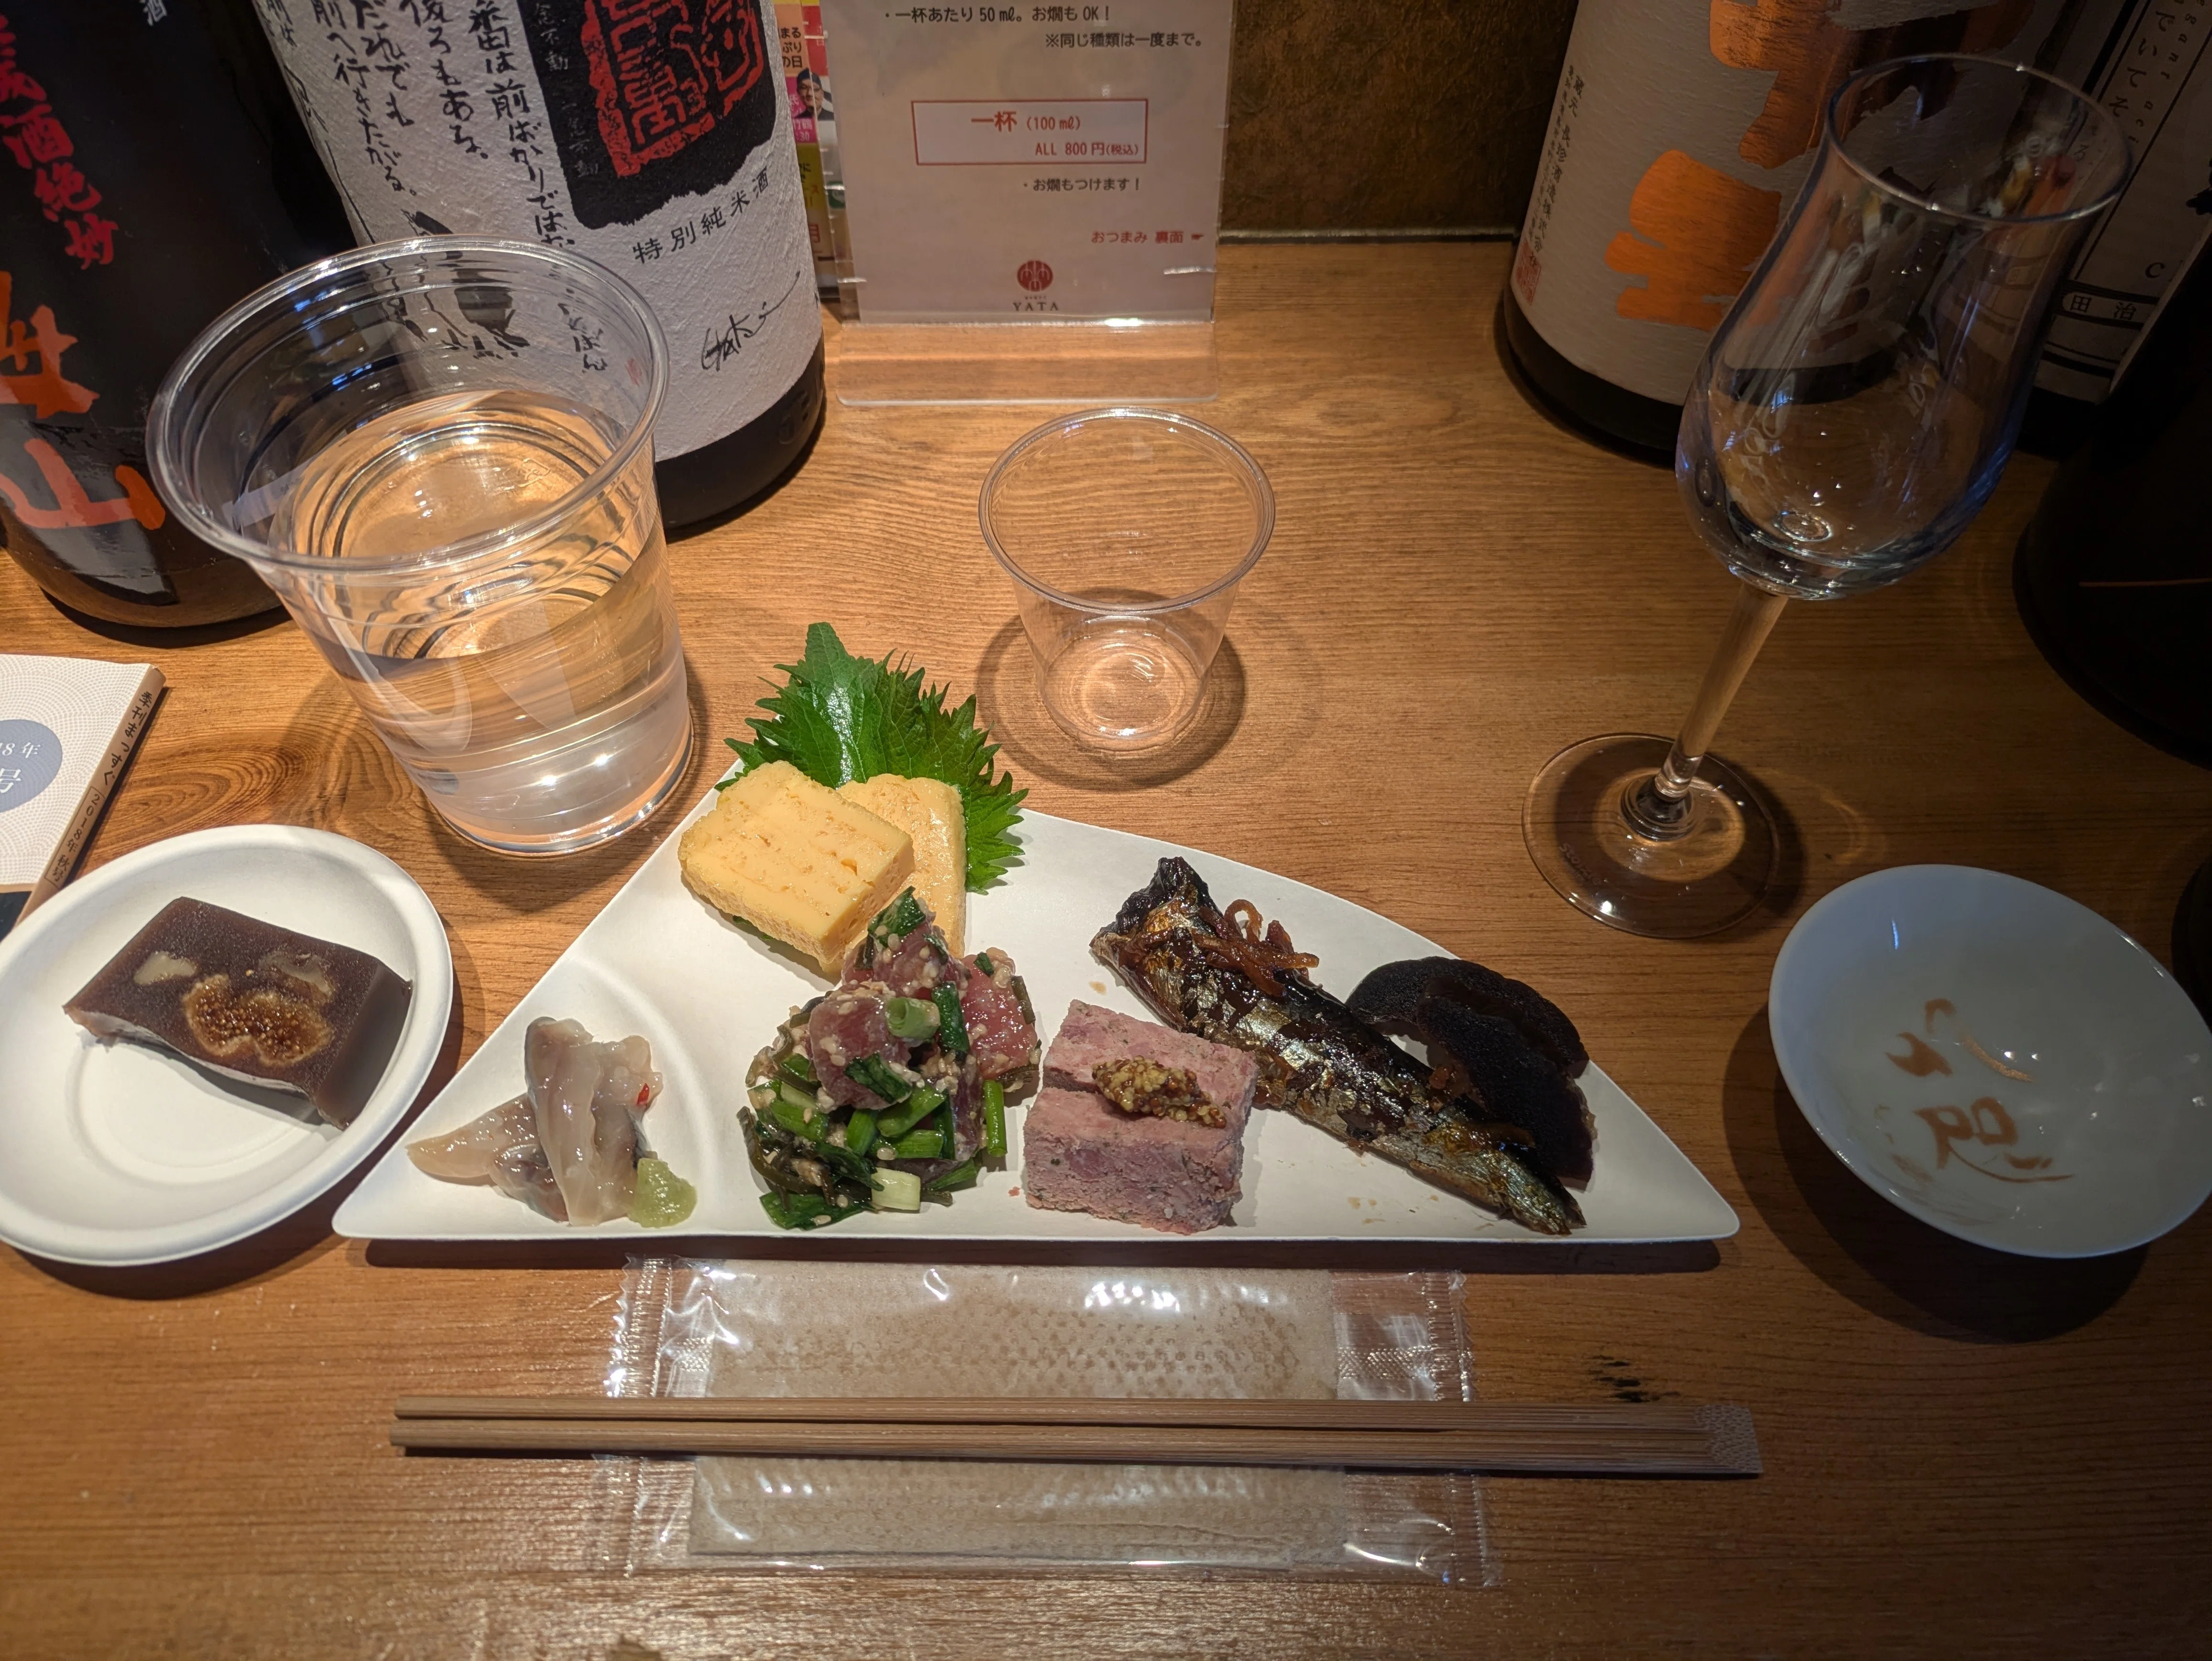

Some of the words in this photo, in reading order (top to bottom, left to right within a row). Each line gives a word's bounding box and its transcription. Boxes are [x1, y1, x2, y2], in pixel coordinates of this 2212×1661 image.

[980, 7, 995, 22] 50
[971, 111, 1018, 133] 一杯
[1035, 144, 1057, 156] ALL
[1065, 143, 1087, 155] 800
[632, 166, 768, 264] 特別純米酒
[1091, 231, 1147, 244] おつまみ
[1155, 231, 1184, 244] 裏面
[1012, 301, 1059, 311] YATA
